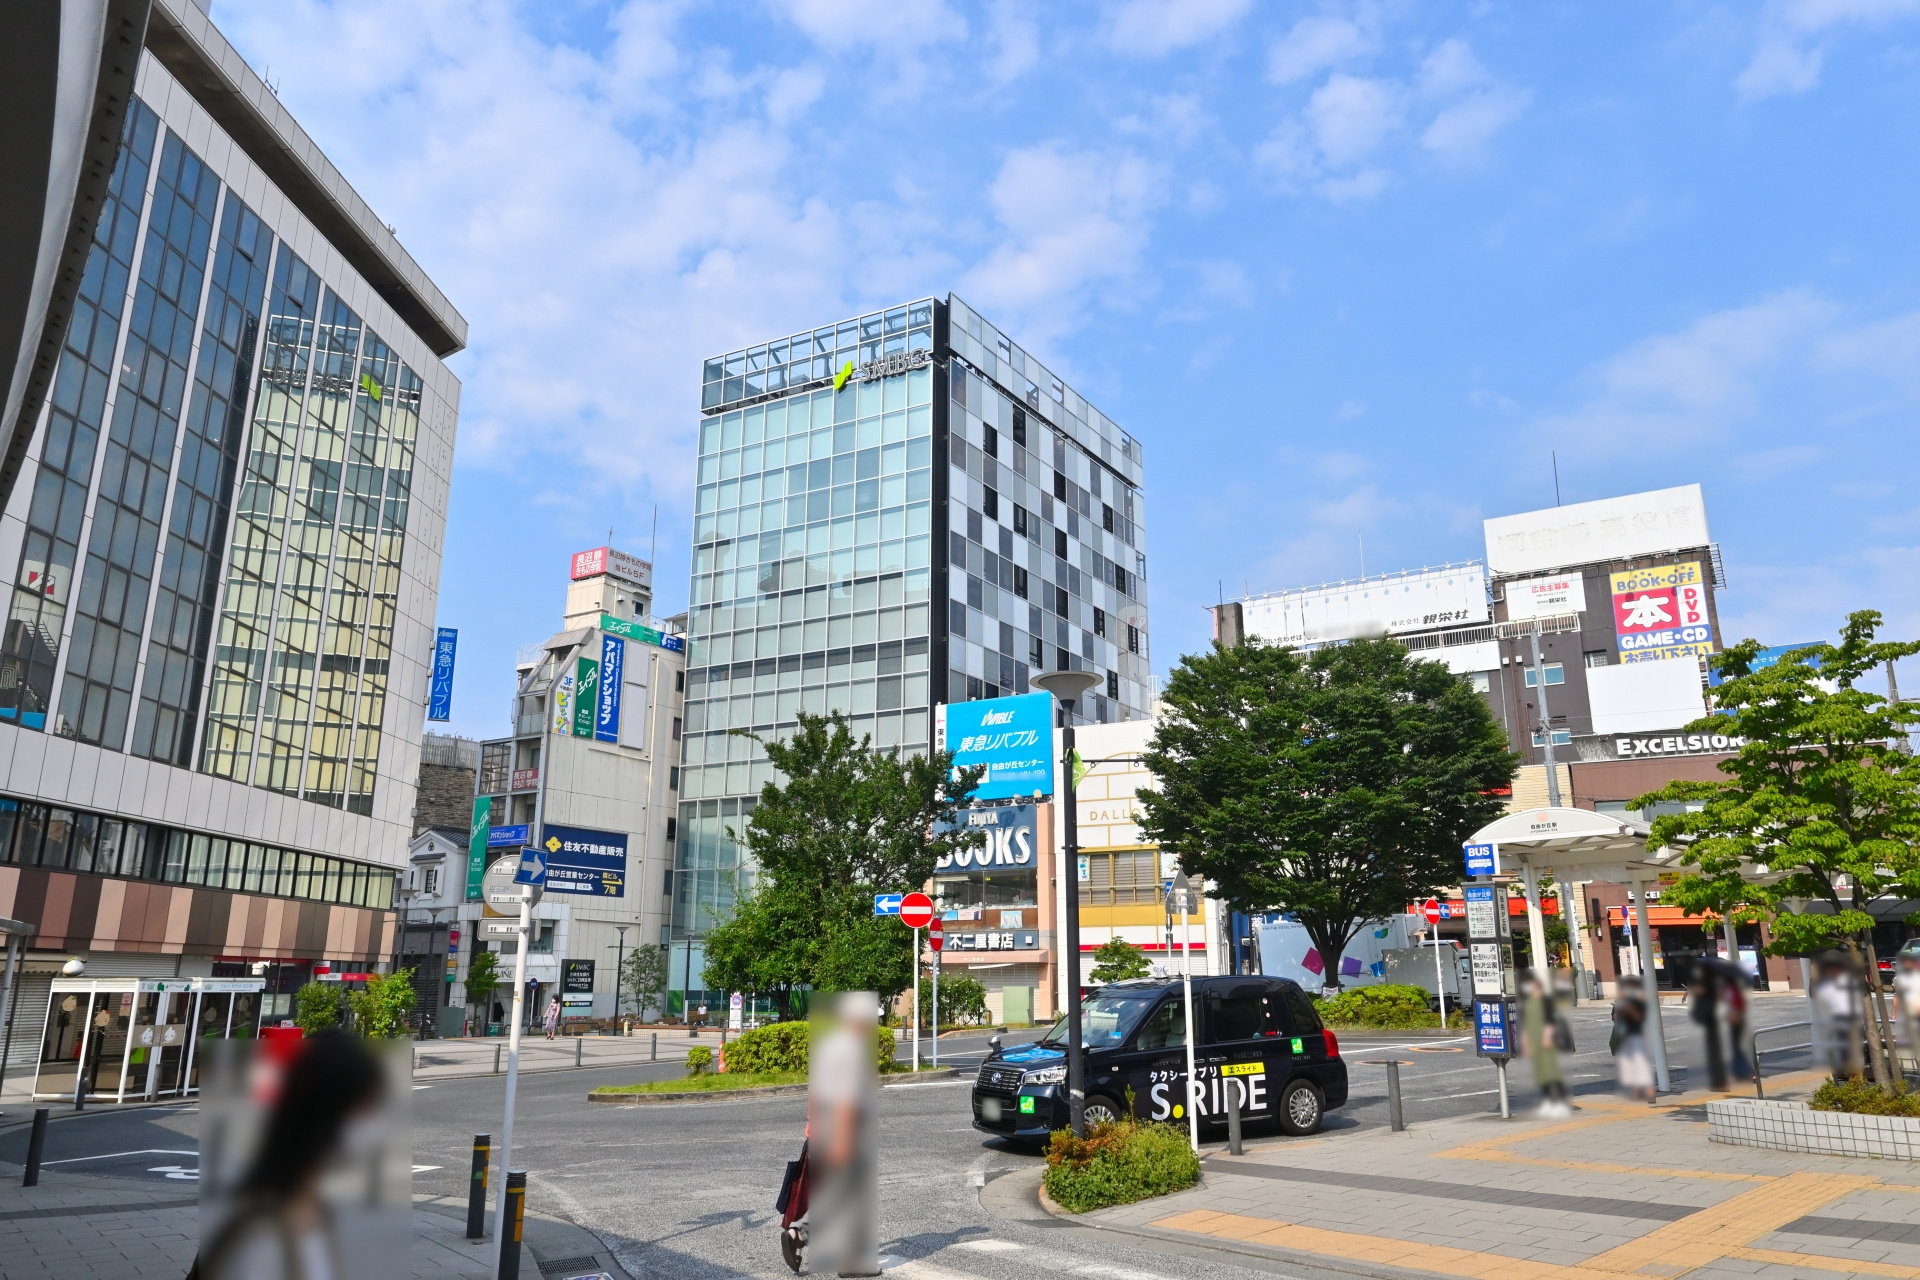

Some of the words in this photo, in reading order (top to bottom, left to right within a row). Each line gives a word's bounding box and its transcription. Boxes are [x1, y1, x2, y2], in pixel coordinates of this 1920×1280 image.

[860, 347, 925, 382] SMBC
[1531, 581, 1570, 594] 広告主募集
[1621, 594, 1673, 628] 本
[1683, 588, 1701, 623] DVD
[1391, 617, 1420, 627] 株式会社
[432, 641, 454, 719] 東急リバブル
[563, 676, 573, 686] 3F
[600, 639, 616, 725] アパマンショップ
[957, 729, 1039, 753] 東急リバブル
[1616, 735, 1746, 756] EXCELSIOR
[991, 758, 1044, 771] 自由が丘センター
[968, 811, 999, 828] FUJIYA
[1530, 822, 1558, 830] 自由が丘駅
[489, 830, 515, 840] アパマンショップ
[563, 840, 624, 858] 住友不動産販売
[1467, 846, 1491, 857] BUS
[603, 884, 617, 895] 7階
[949, 932, 1014, 949] 不二屋書店
[1480, 1003, 1500, 1013] 内科
[1481, 1013, 1501, 1024] 歯科
[1150, 1074, 1267, 1120] S.RIDE
